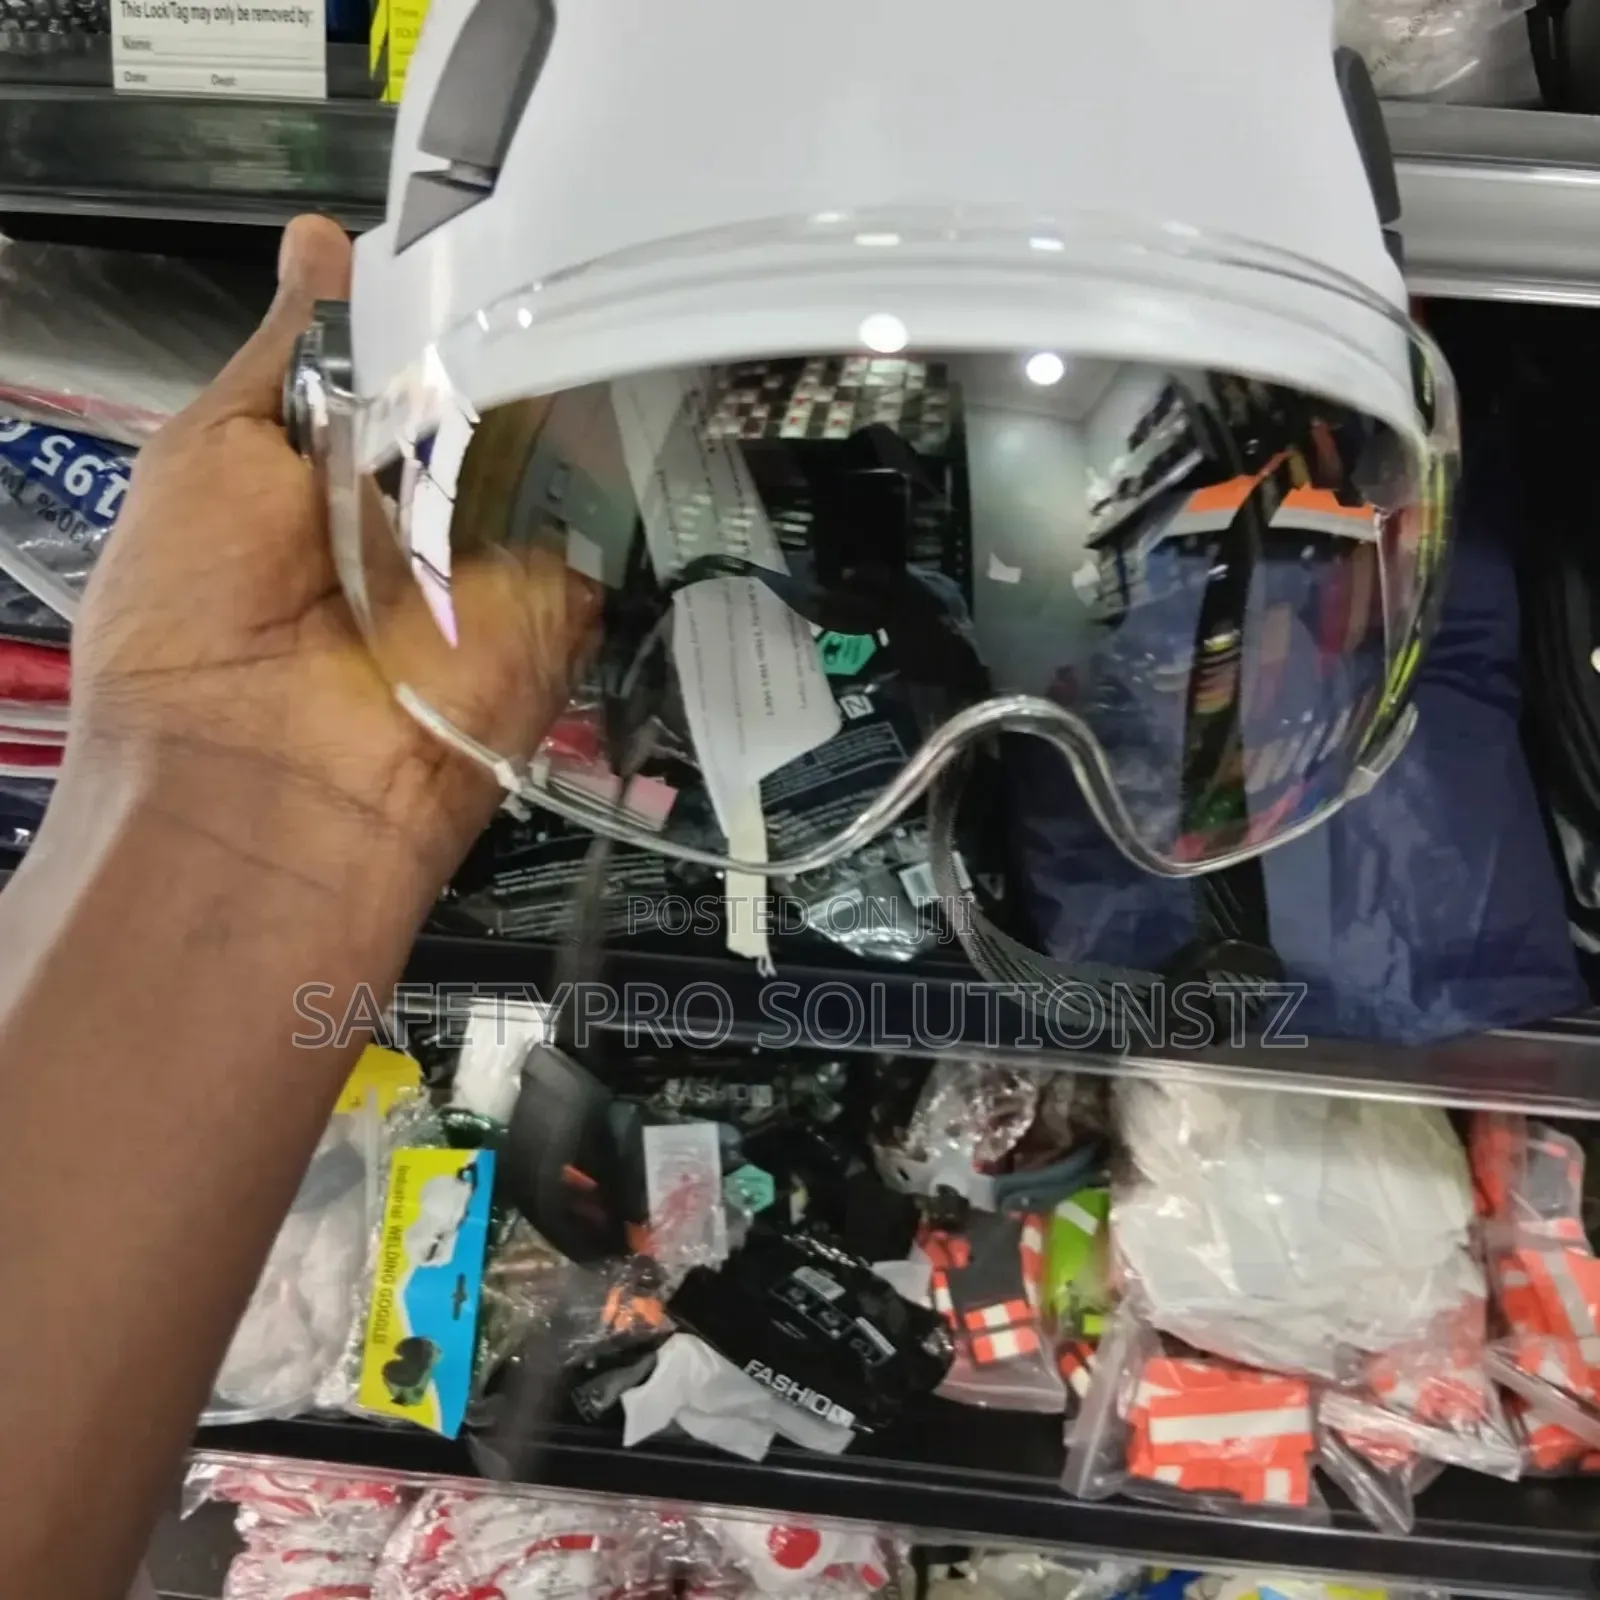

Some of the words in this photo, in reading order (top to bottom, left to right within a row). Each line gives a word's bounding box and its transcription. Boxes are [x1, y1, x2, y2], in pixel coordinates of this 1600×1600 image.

[120, 1, 142, 19] This
[190, 6, 211, 25] may
[214, 4, 235, 25] only
[237, 4, 249, 22] be
[251, 6, 297, 23] removed
[381, 1226, 402, 1285] WELDING
